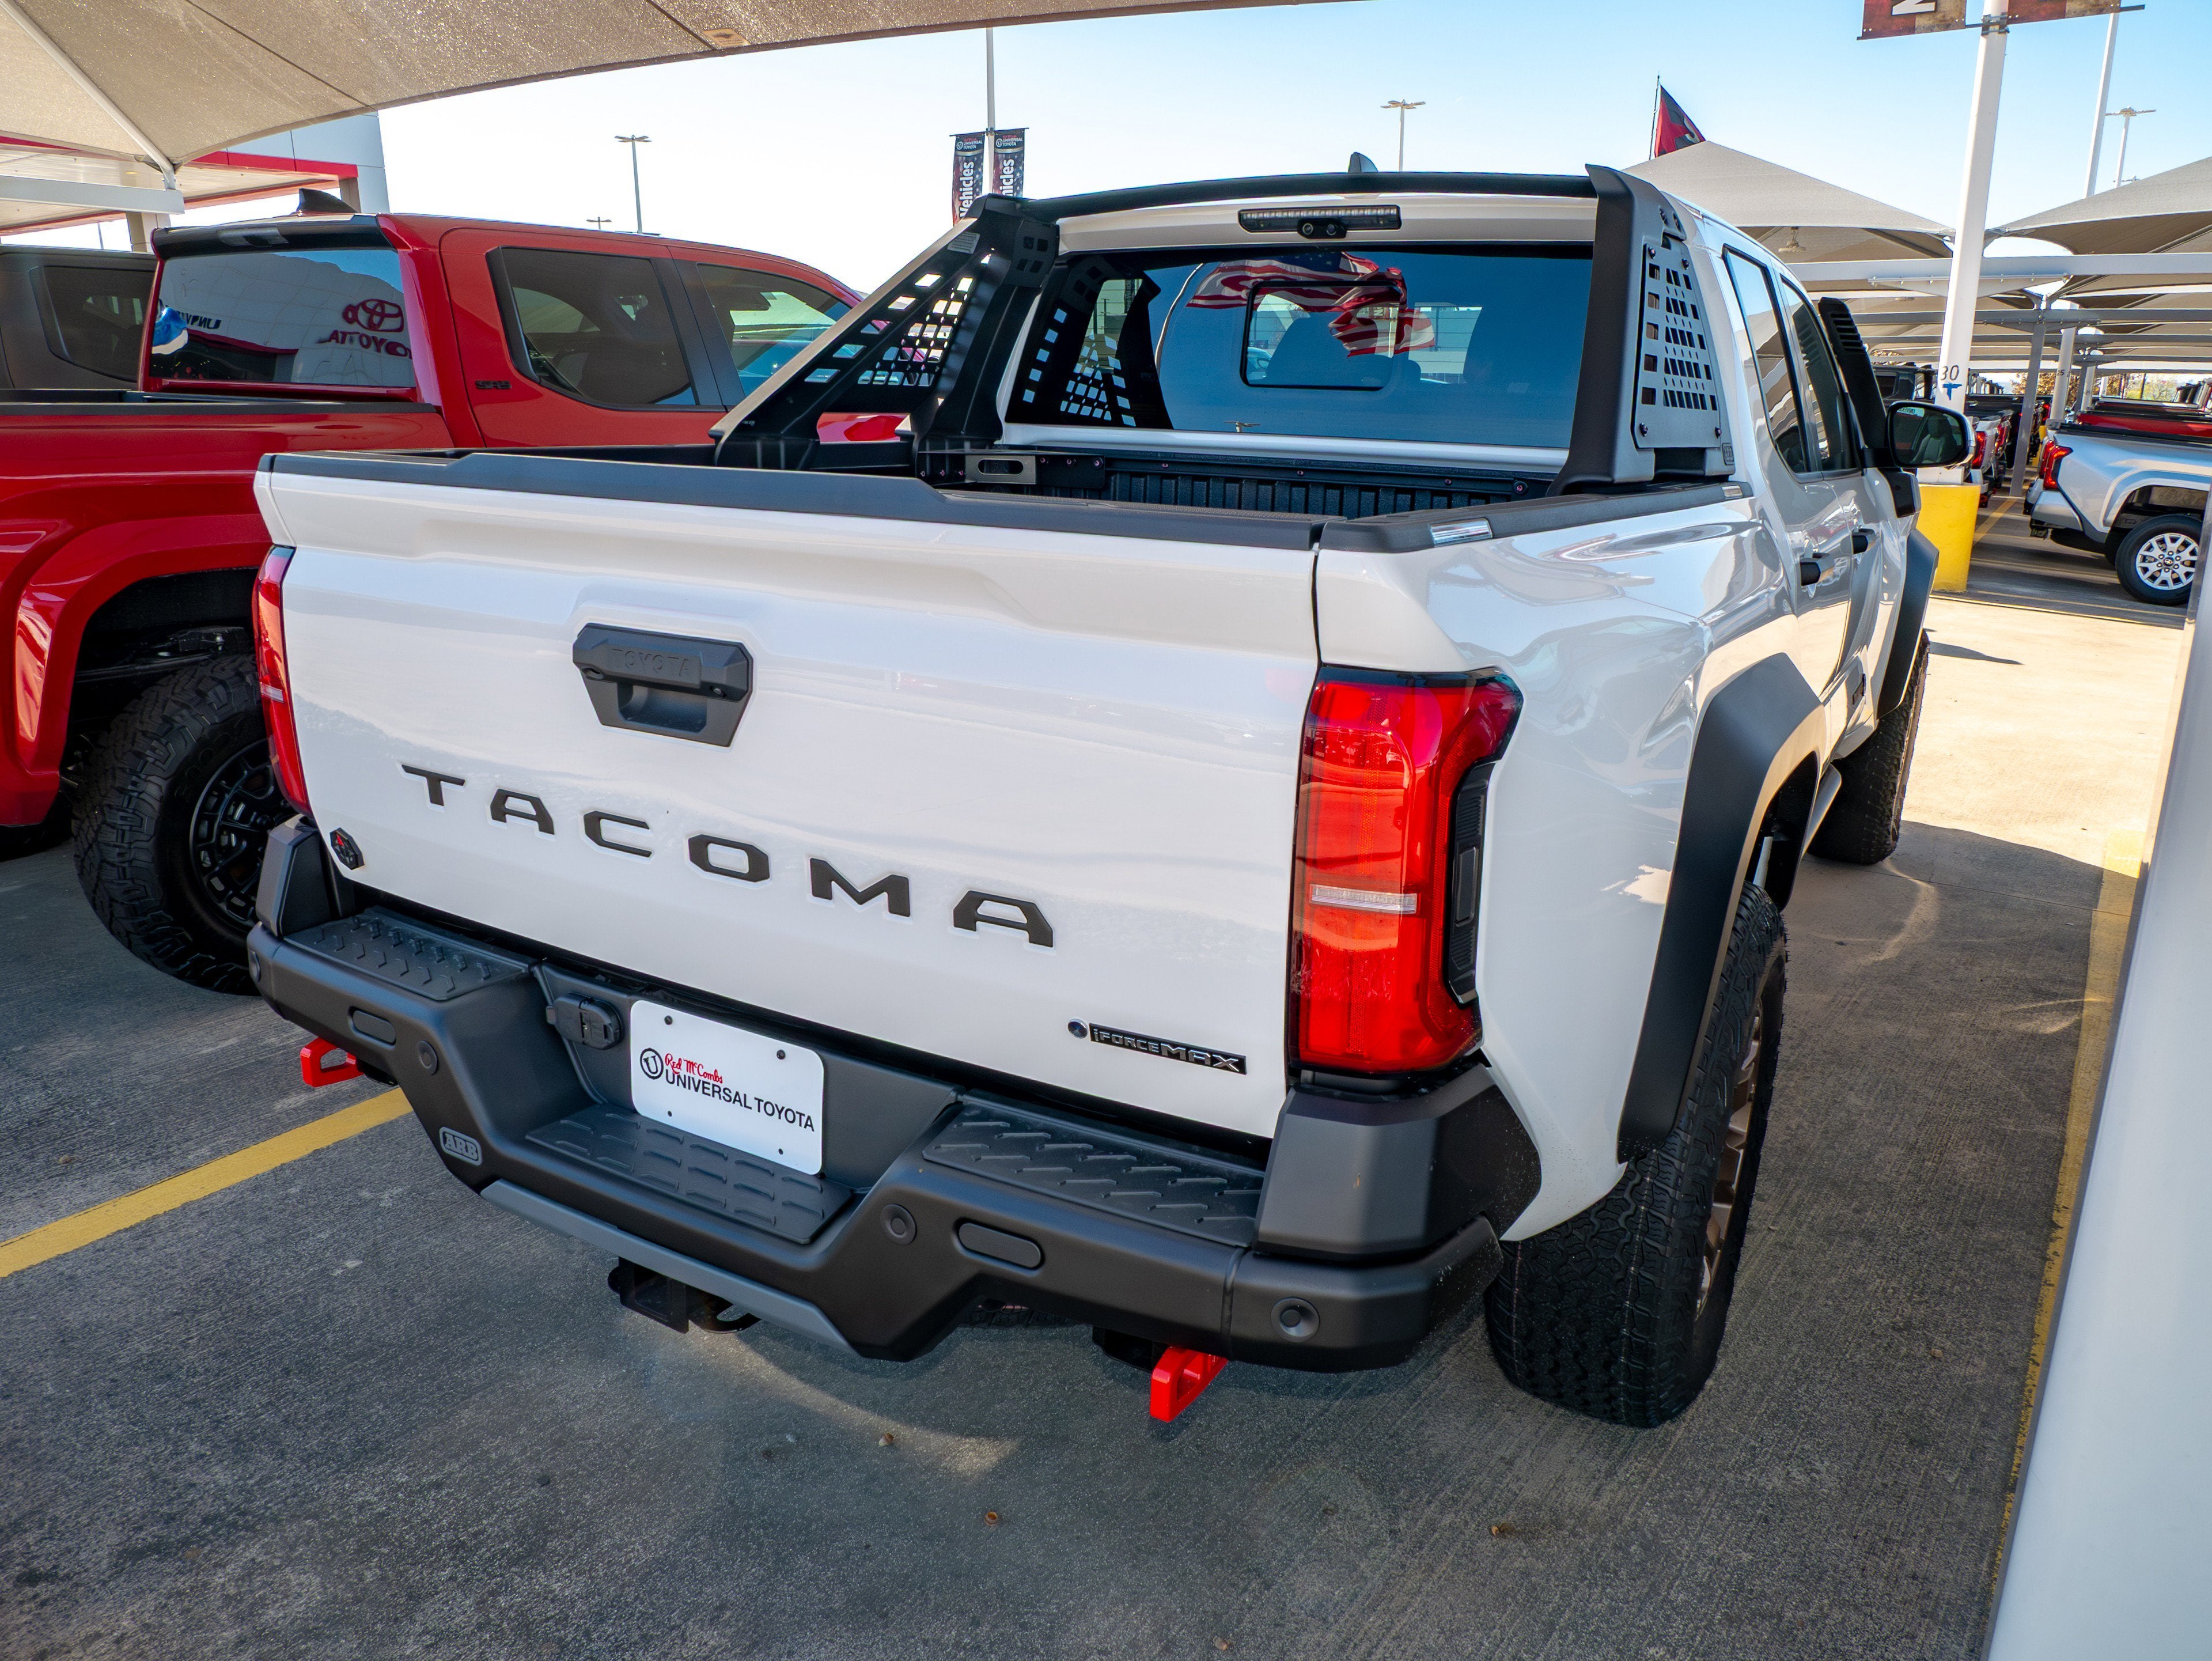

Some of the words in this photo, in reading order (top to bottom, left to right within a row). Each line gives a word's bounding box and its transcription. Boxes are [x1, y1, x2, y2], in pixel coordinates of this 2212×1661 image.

[1940, 365, 1959, 381] 30
[612, 648, 690, 678] TOYOTA
[400, 764, 1054, 948] TACOMA
[665, 1053, 683, 1074] Red
[684, 1058, 724, 1084] McCombs
[665, 1069, 752, 1110] UNIVERSAL
[754, 1096, 815, 1132] TOYOTA
[444, 1133, 479, 1161] ARB
